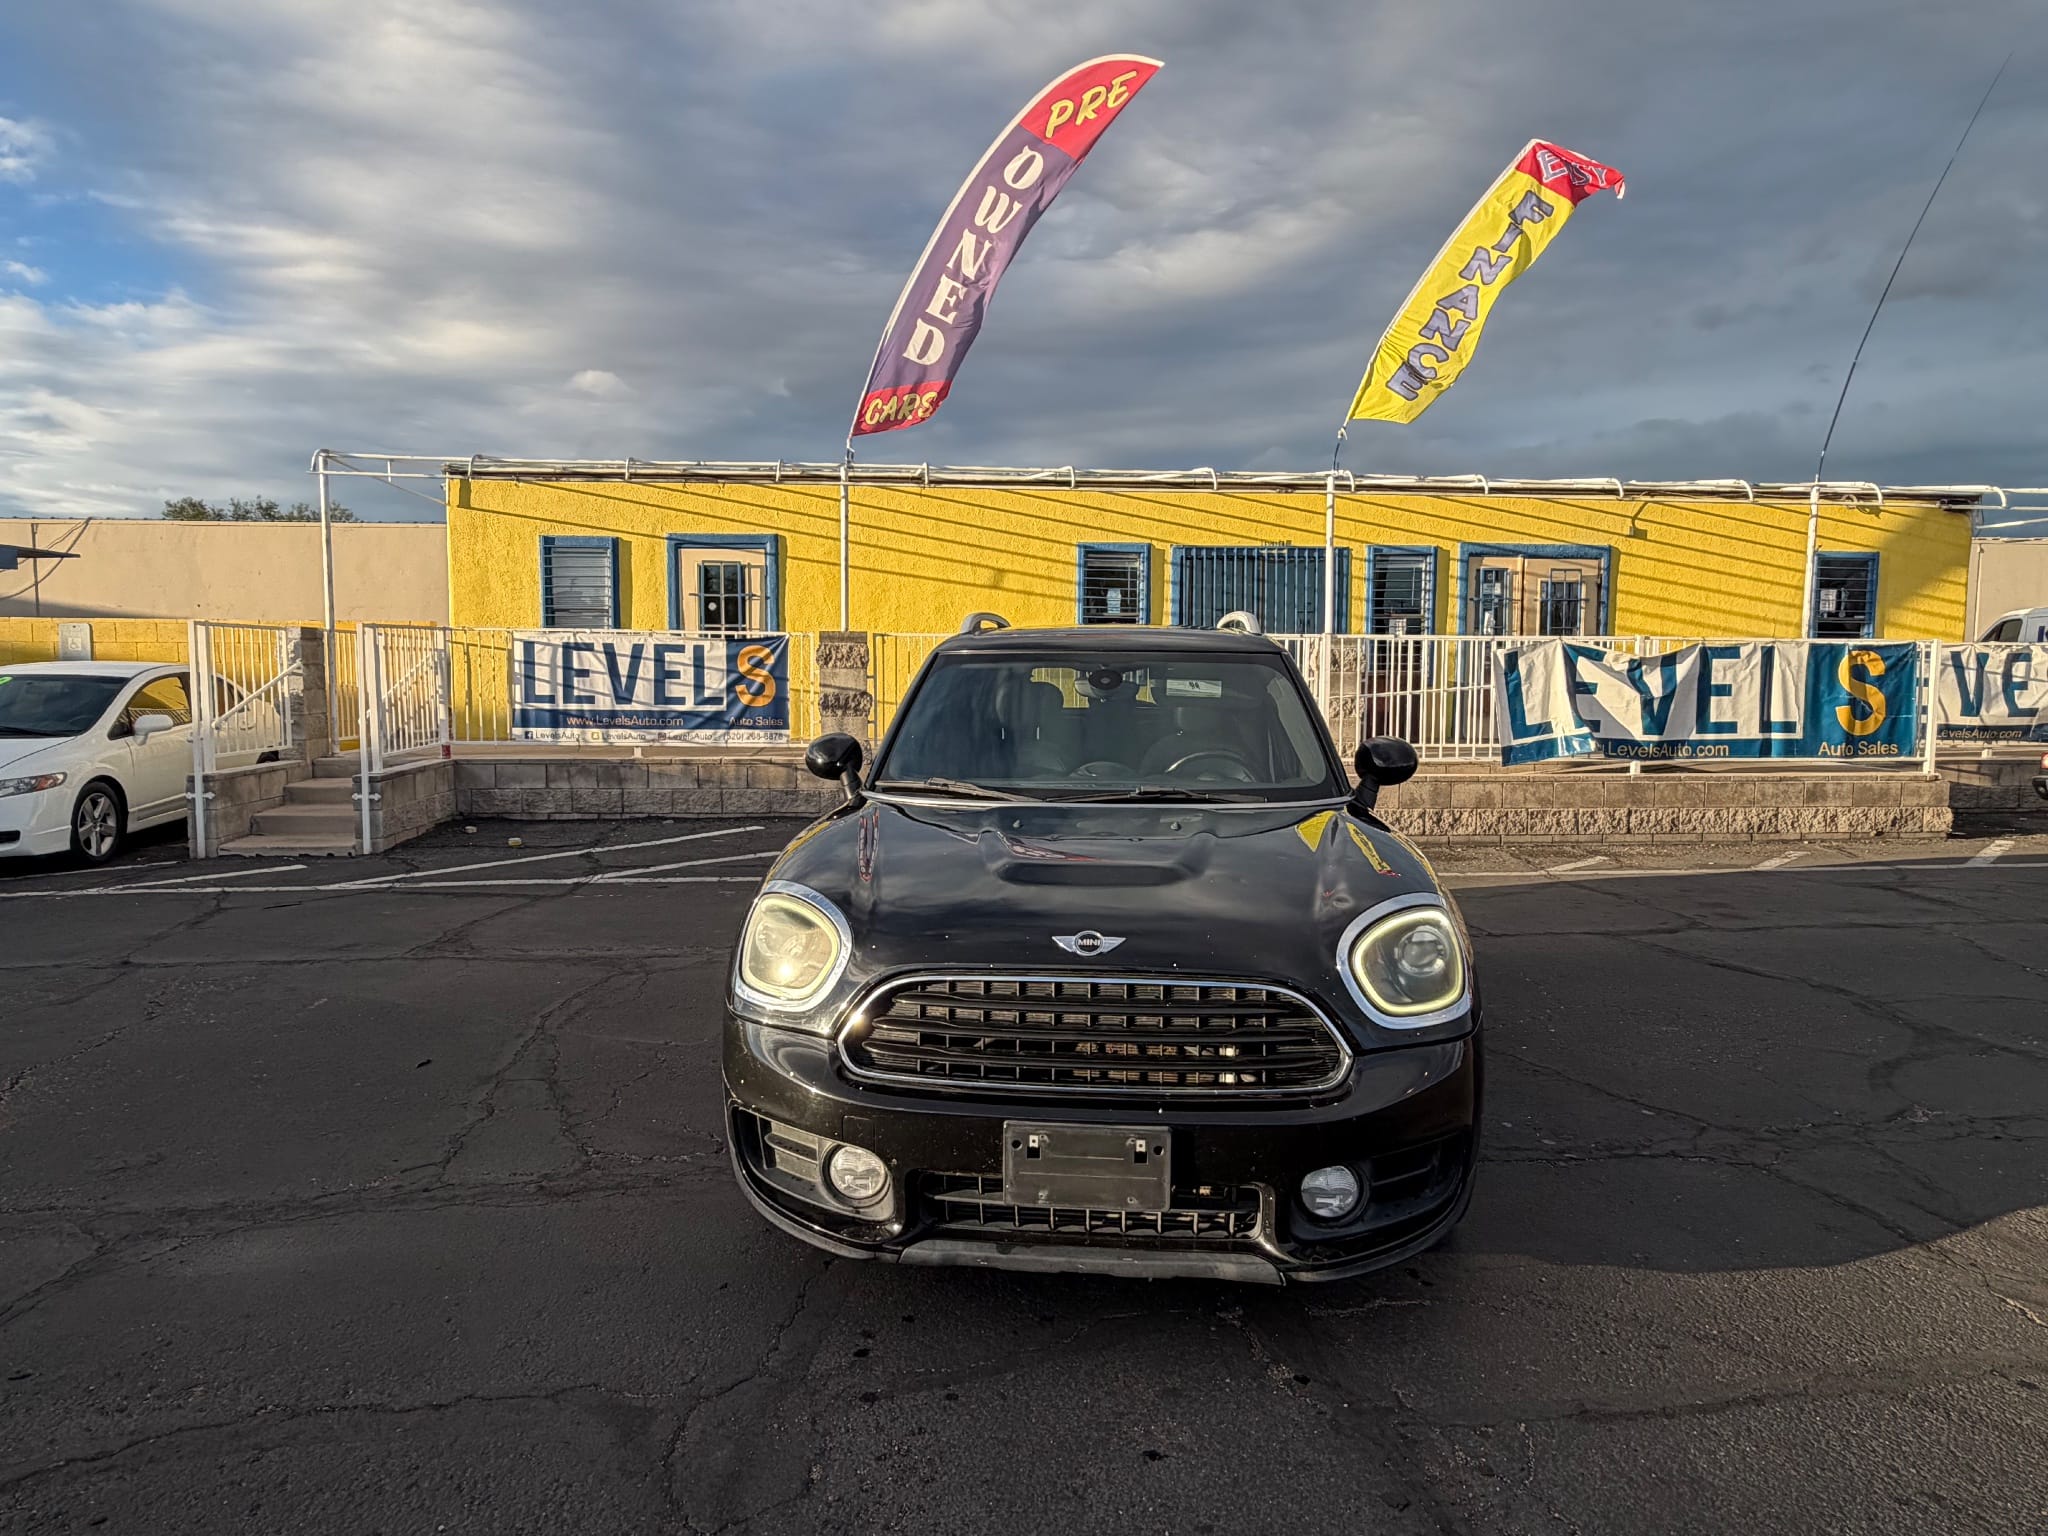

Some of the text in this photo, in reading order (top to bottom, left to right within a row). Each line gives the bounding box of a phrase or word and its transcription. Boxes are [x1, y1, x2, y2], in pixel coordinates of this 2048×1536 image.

[1044, 70, 1138, 139] PRE
[902, 145, 1044, 366] OWNED
[1385, 189, 1555, 401] FINANCE
[864, 391, 938, 425] CARS
[522, 640, 777, 708] LEVELS
[1504, 643, 1886, 740] LEVELS
[566, 714, 684, 726] www.LevelsAuto.com
[729, 716, 784, 726] Auto Sales
[1818, 740, 1899, 756] Auto Sales
[1077, 938, 1101, 946] MINI
